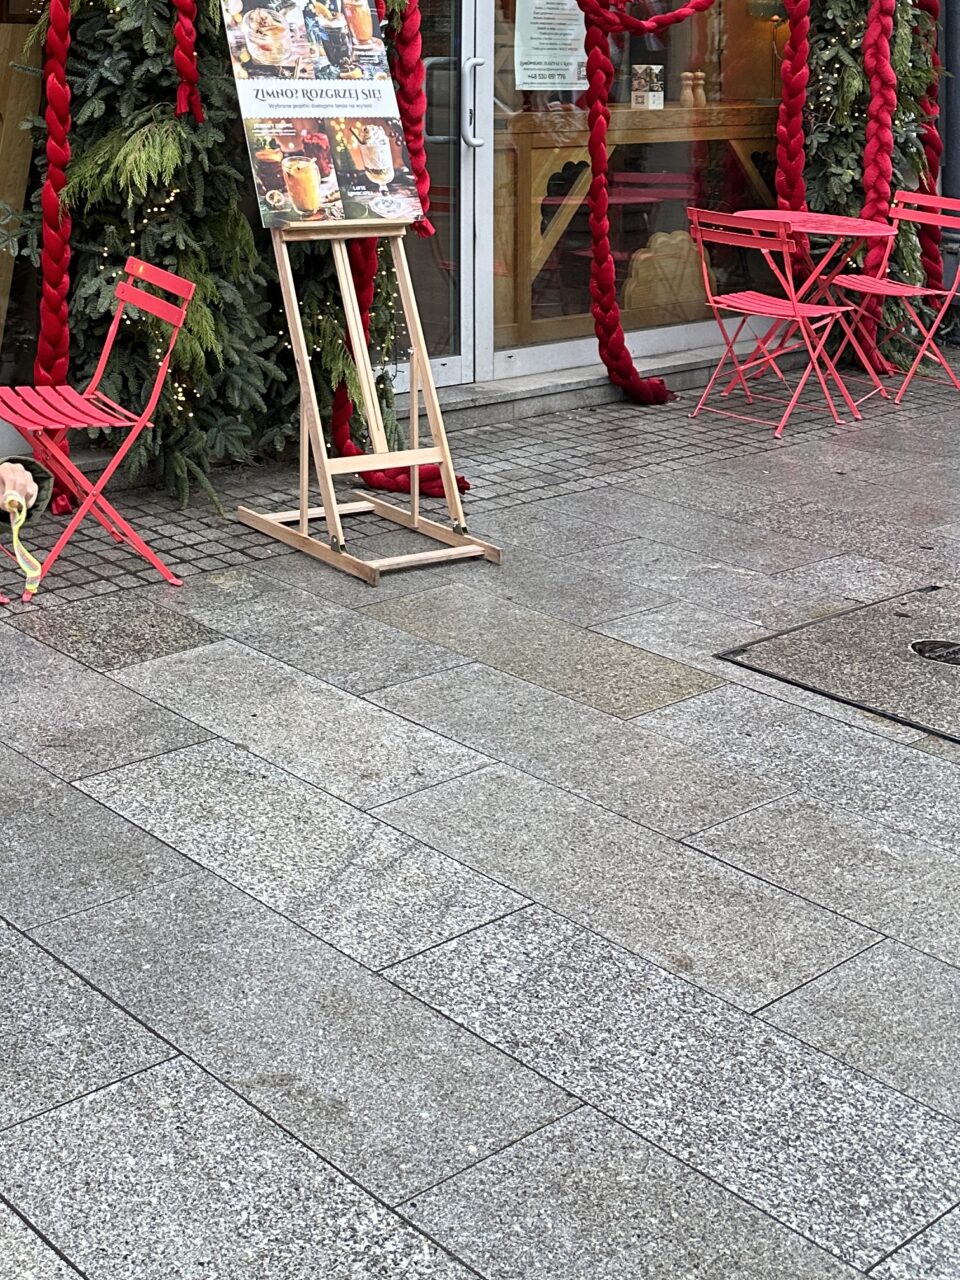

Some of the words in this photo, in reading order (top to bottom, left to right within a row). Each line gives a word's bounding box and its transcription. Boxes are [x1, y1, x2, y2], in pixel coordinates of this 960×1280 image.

[253, 88, 299, 102] ZIMNO?
[301, 88, 359, 102] ROZGRZEJ
[361, 88, 382, 102] SIĘ!
